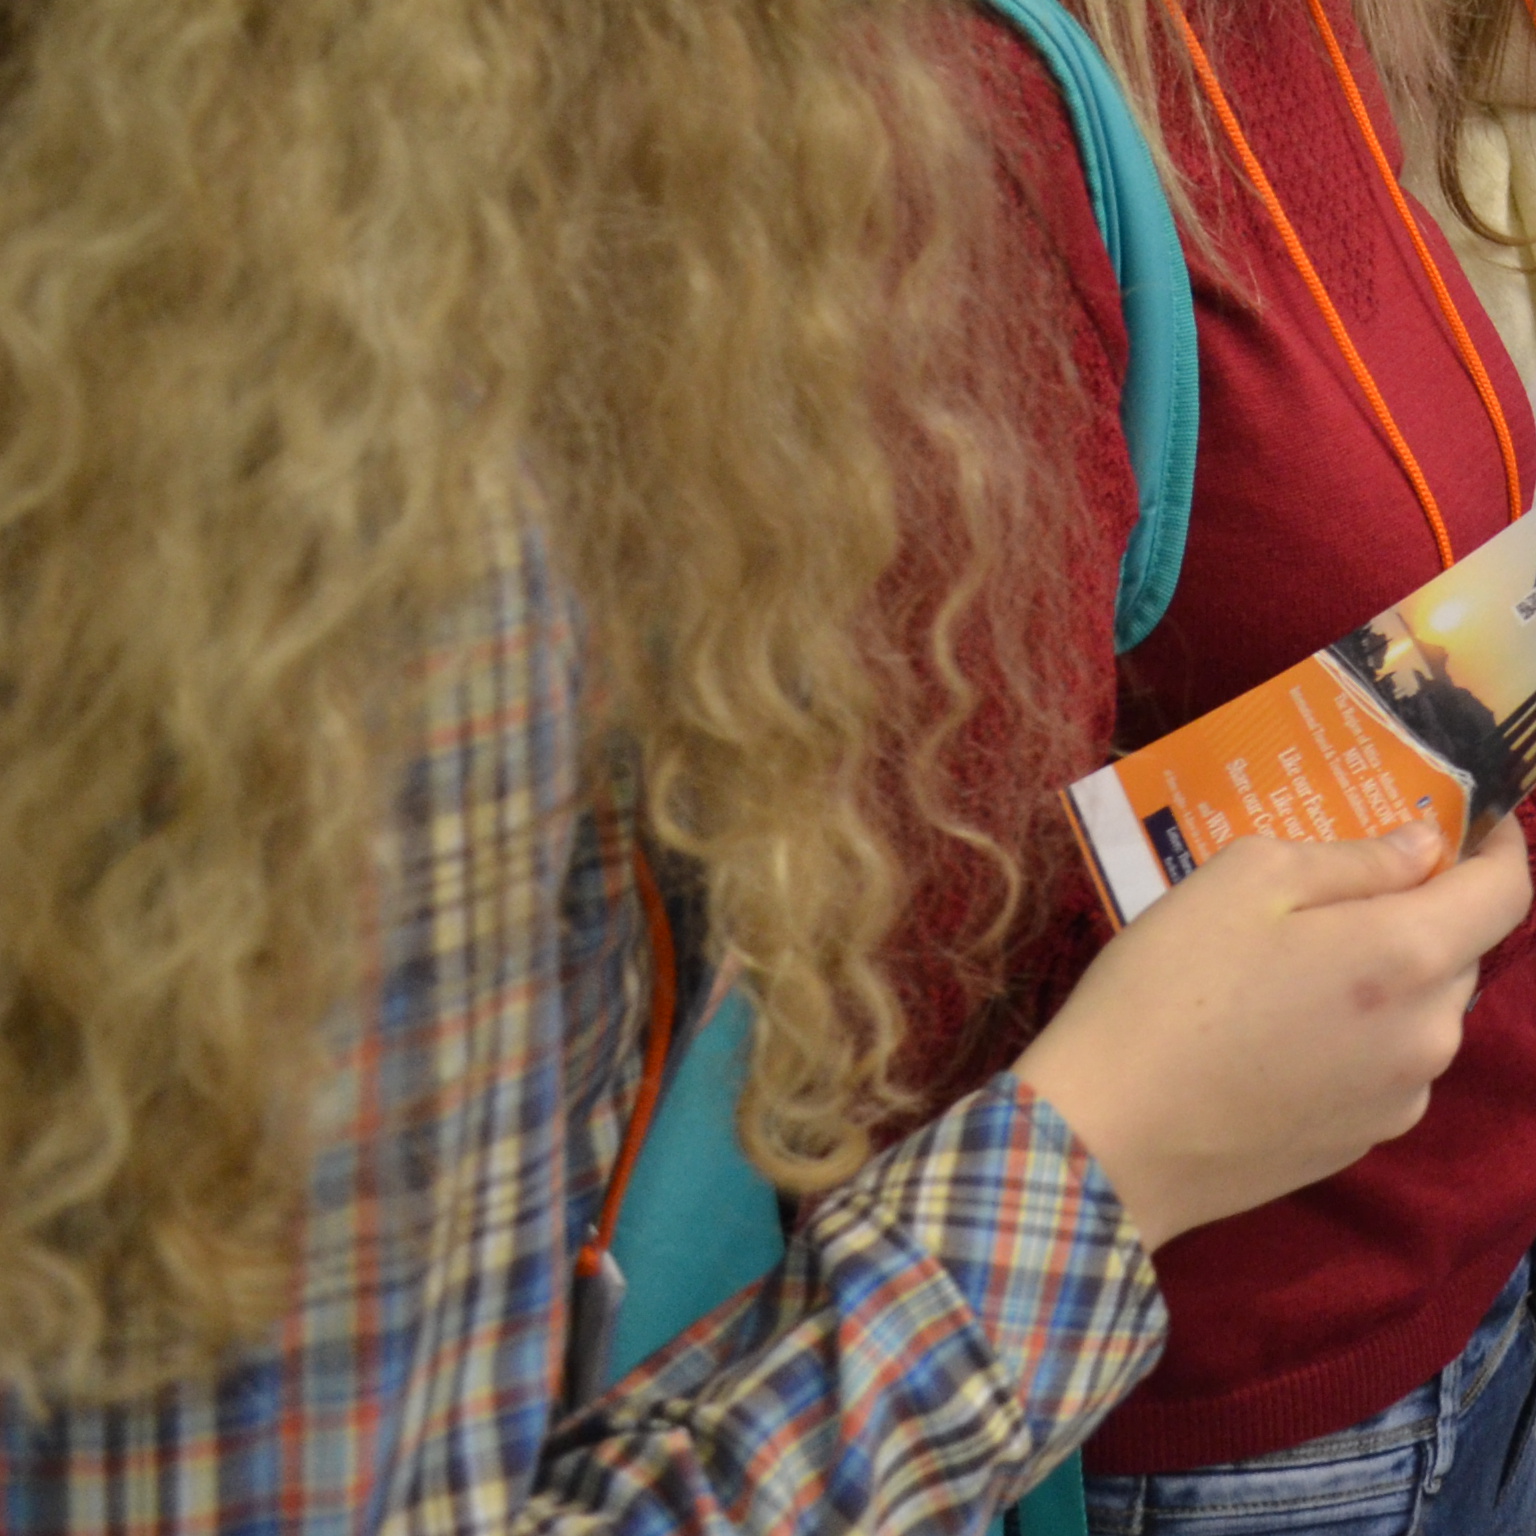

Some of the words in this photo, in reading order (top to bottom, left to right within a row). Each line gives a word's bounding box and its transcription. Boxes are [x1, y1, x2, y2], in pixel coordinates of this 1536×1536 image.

[1341, 707, 1365, 737] Region
[1356, 732, 1371, 745] of
[1276, 745, 1303, 776] Like
[1291, 774, 1312, 797] our
[1361, 743, 1382, 769] Attica
[1225, 757, 1251, 793] Share
[1241, 791, 1263, 815] our
[1342, 746, 1367, 775] MITT
[1359, 777, 1395, 826] MOSCOW
[1378, 770, 1401, 801] Athens
[1205, 810, 1234, 844] WIN
[1268, 785, 1292, 817] Like
[1282, 814, 1304, 838] our
